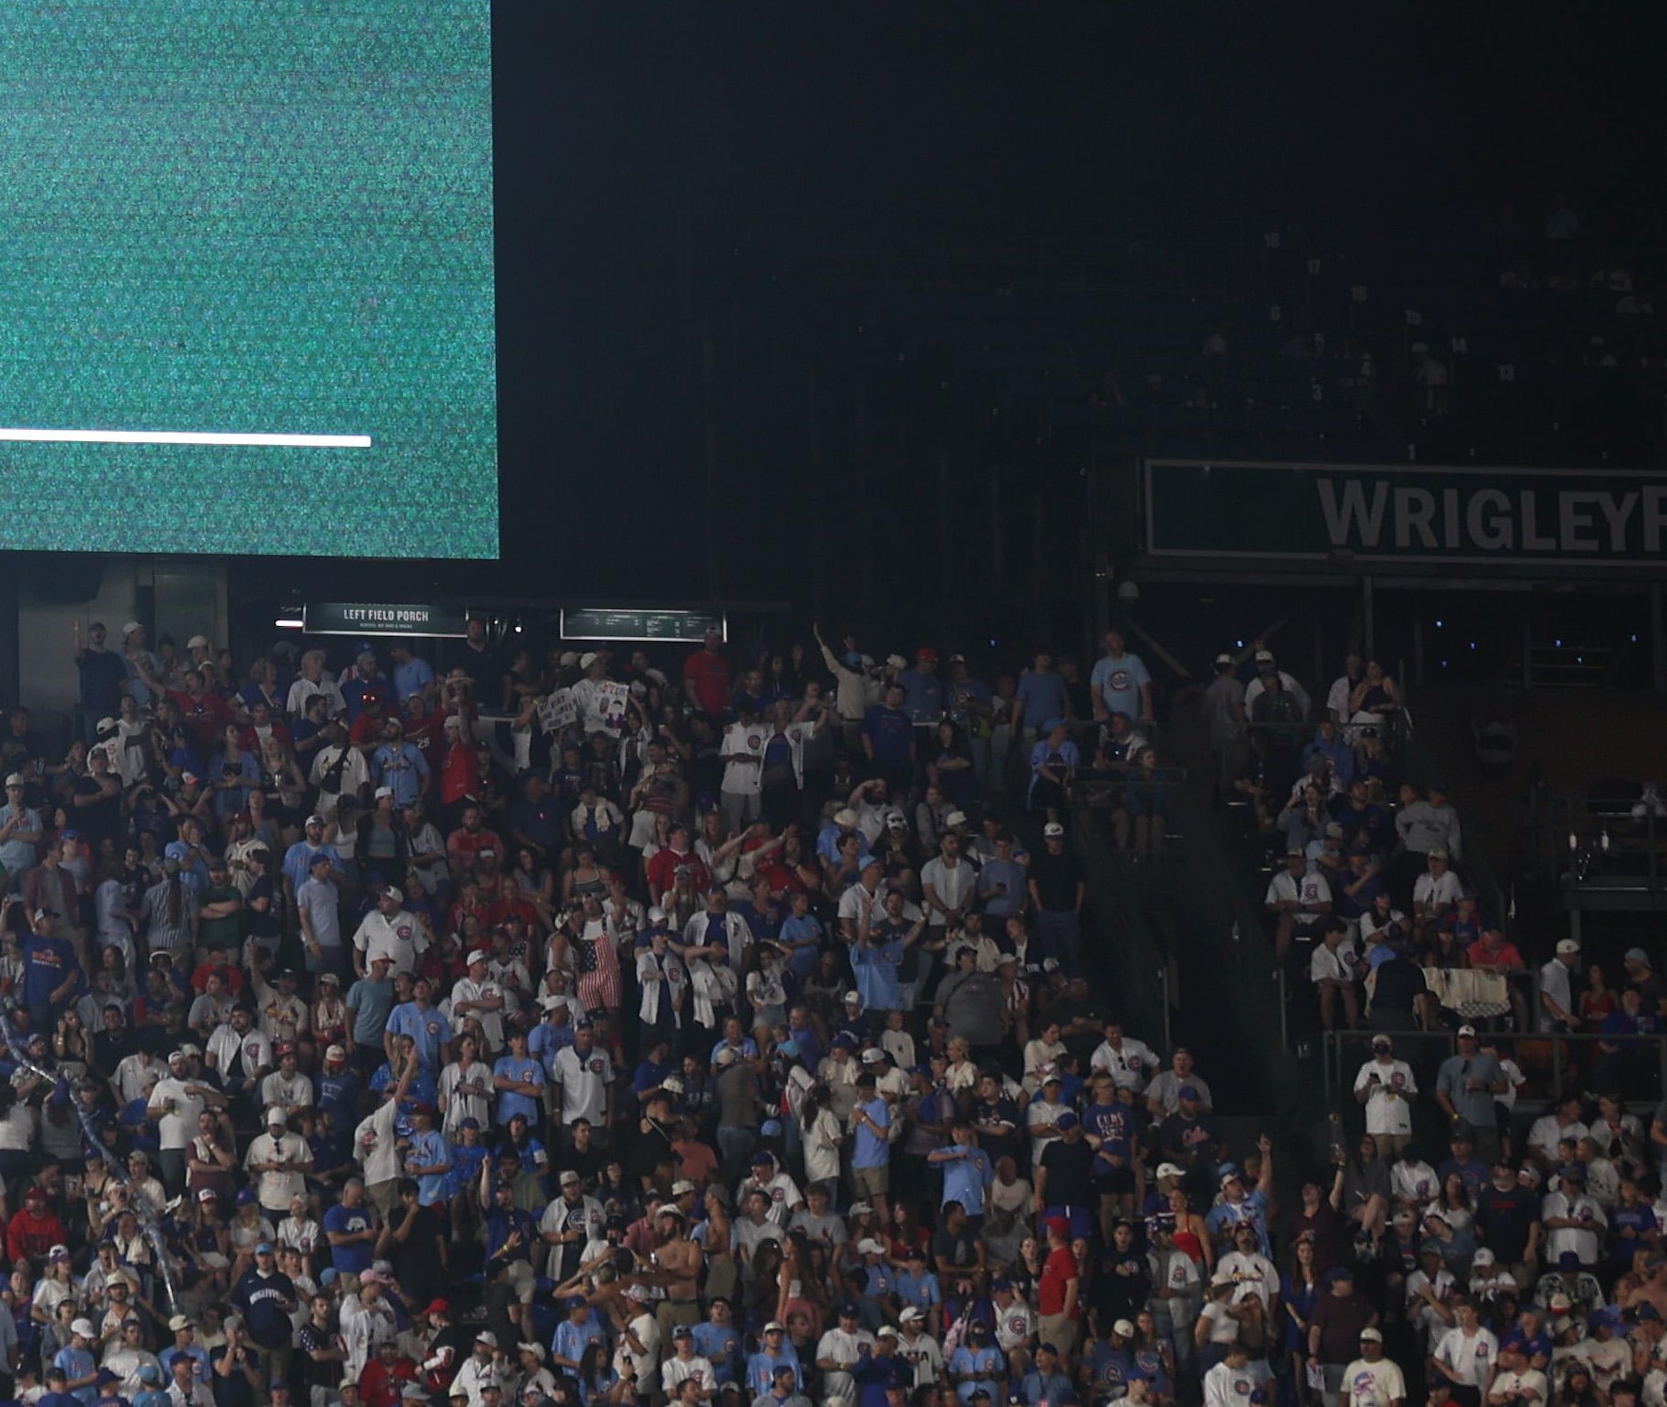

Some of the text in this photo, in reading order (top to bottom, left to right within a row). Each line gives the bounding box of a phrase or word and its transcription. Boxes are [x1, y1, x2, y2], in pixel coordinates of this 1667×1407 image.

[343, 608, 429, 623] LEFT FIELD PORCH
